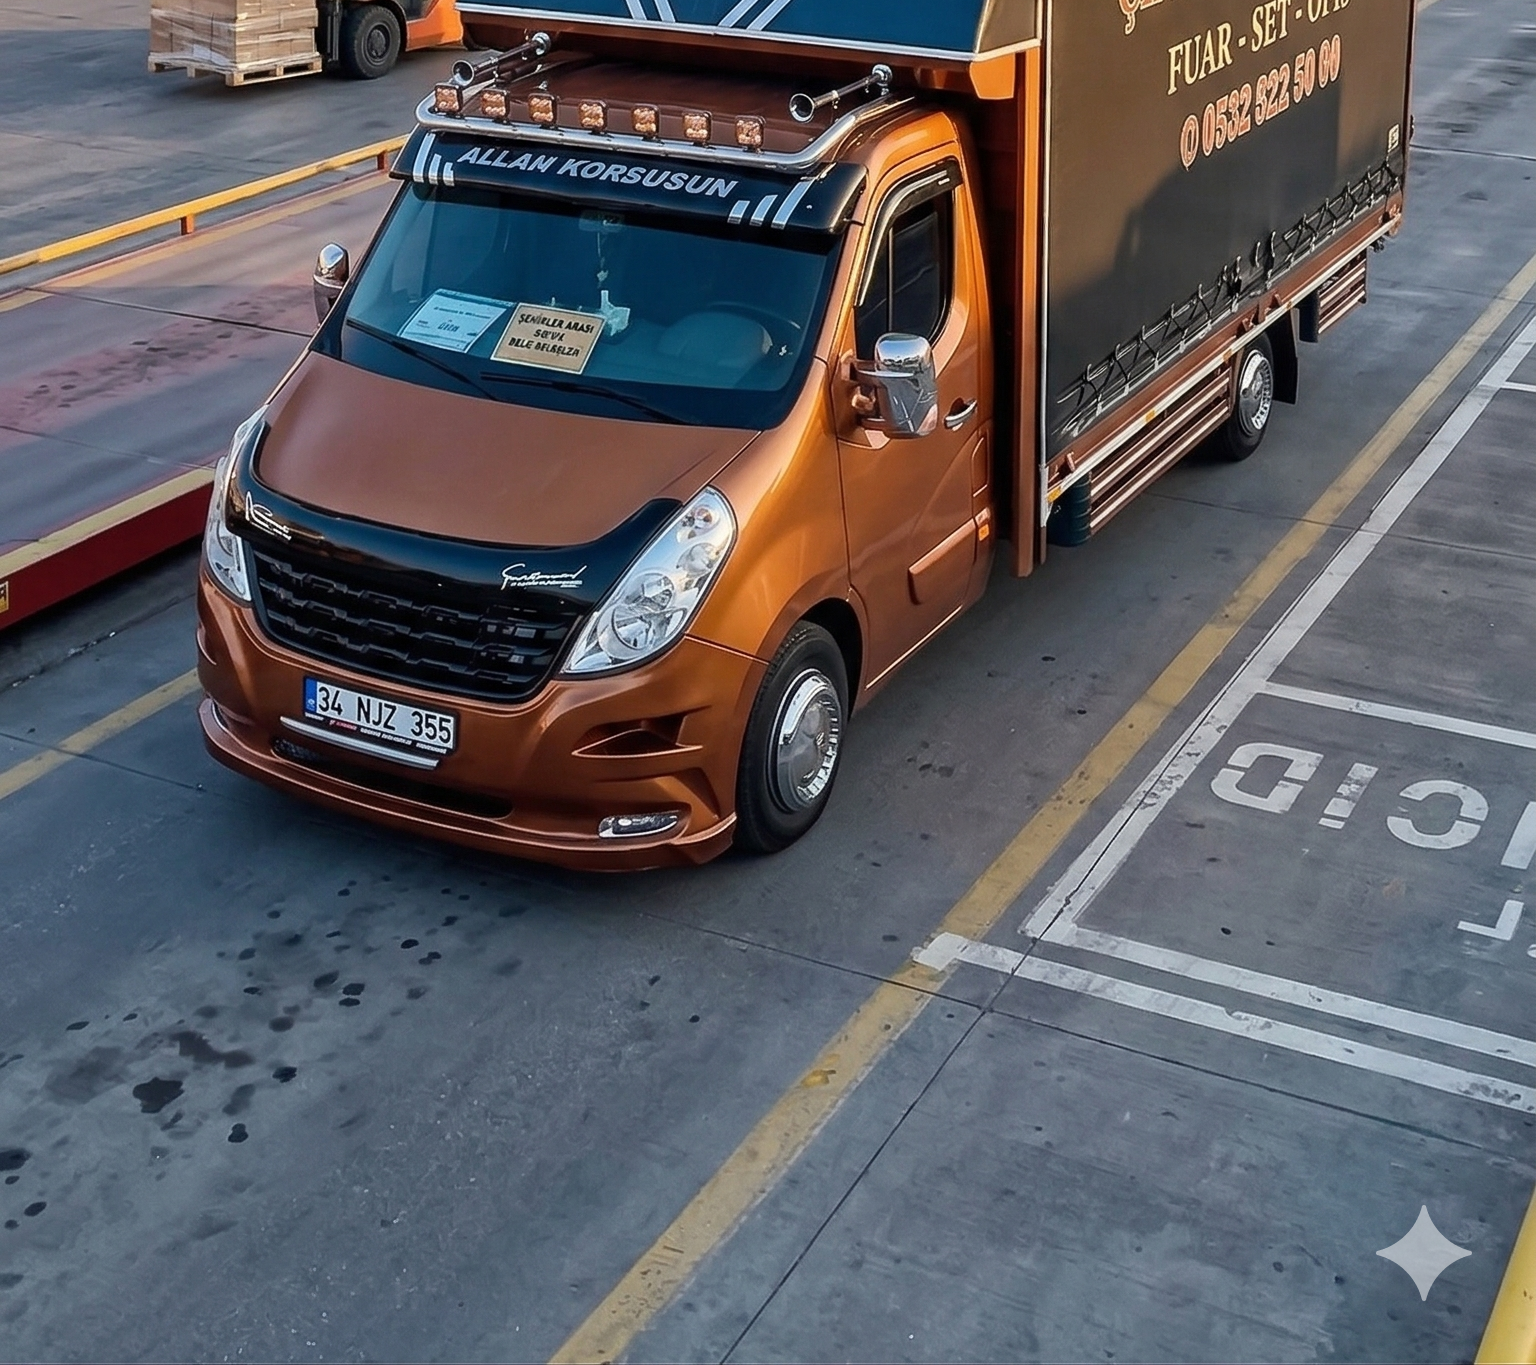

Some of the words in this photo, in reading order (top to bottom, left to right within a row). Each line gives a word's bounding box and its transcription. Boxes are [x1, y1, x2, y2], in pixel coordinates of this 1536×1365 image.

[1167, 22, 1233, 96] FUAR
[457, 146, 558, 173] ALLAN
[556, 158, 738, 198] KORSUSUN
[318, 686, 343, 716] 34
[356, 696, 397, 731] NJZ
[410, 710, 451, 744] 355
